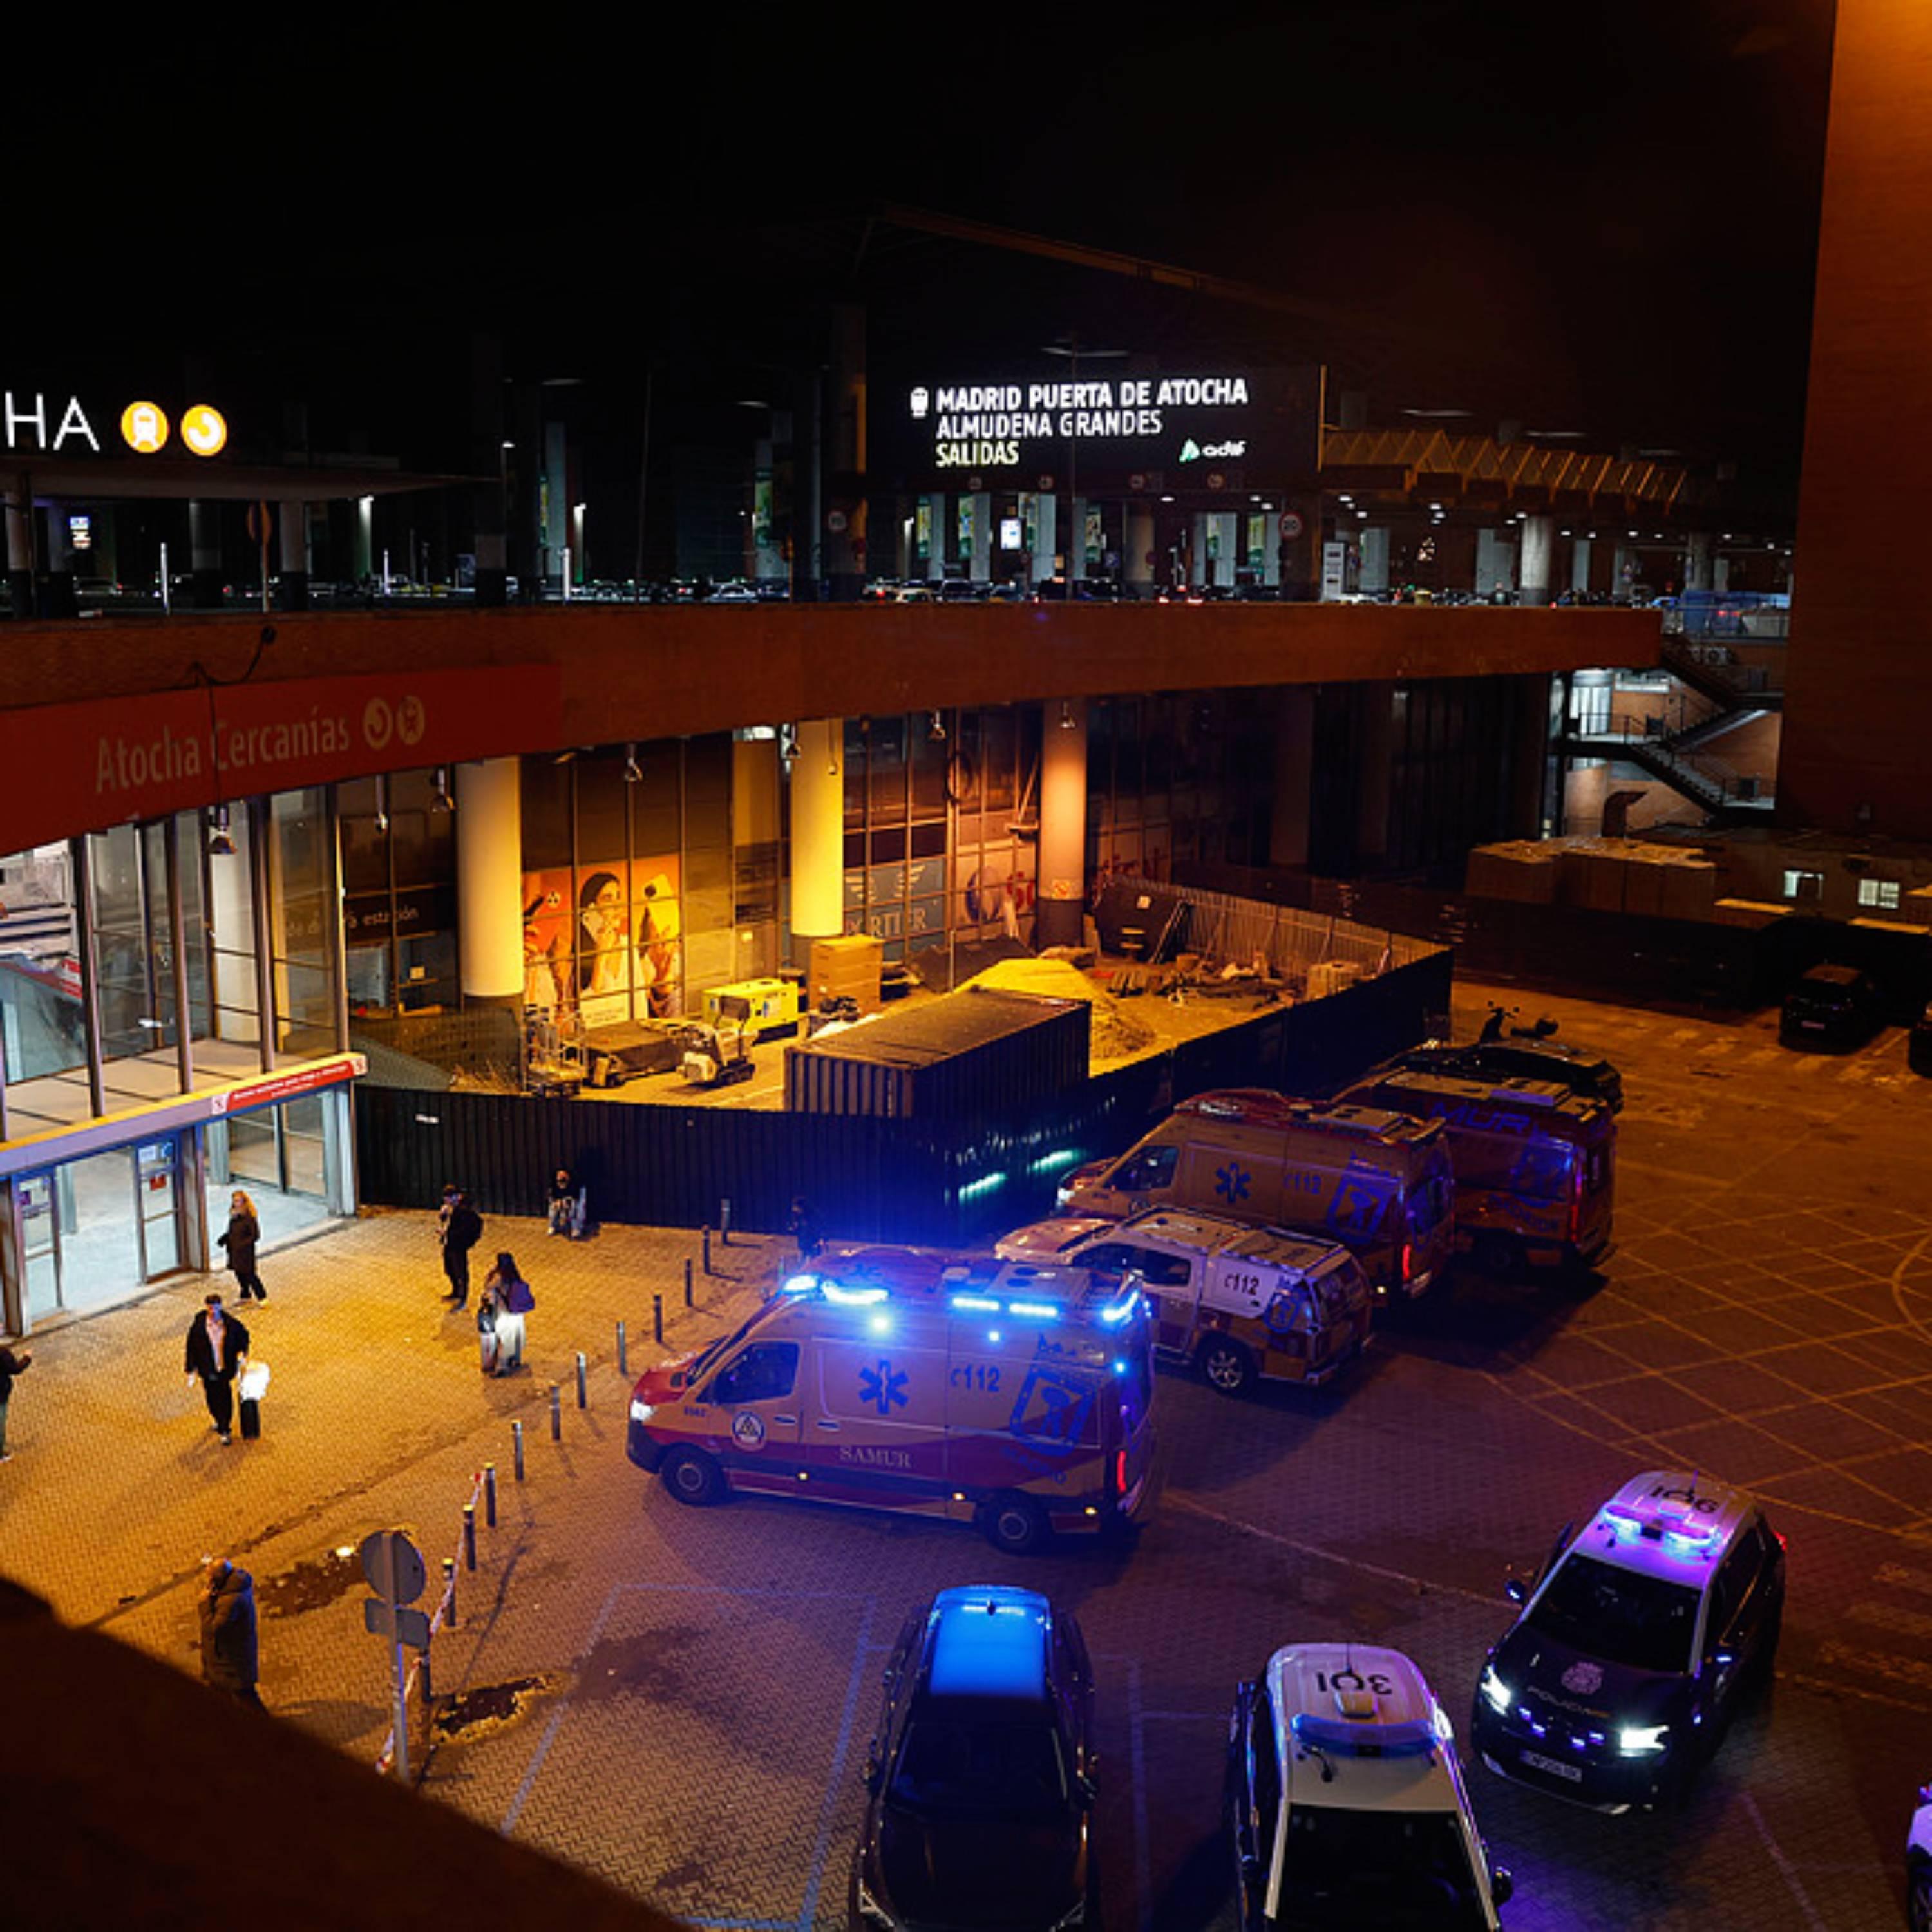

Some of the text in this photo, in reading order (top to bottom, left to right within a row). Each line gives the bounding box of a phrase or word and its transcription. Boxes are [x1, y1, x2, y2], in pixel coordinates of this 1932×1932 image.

[936, 378, 1248, 413] MADRID PUERTA DE ATOCHA
[5, 390, 100, 451] HA
[936, 410, 1162, 439] ALMUDENA GRANDES
[936, 441, 1019, 468] SALIDAS
[95, 705, 350, 794] Atocha Cercanías
[838, 1444, 912, 1469] SAMUR
